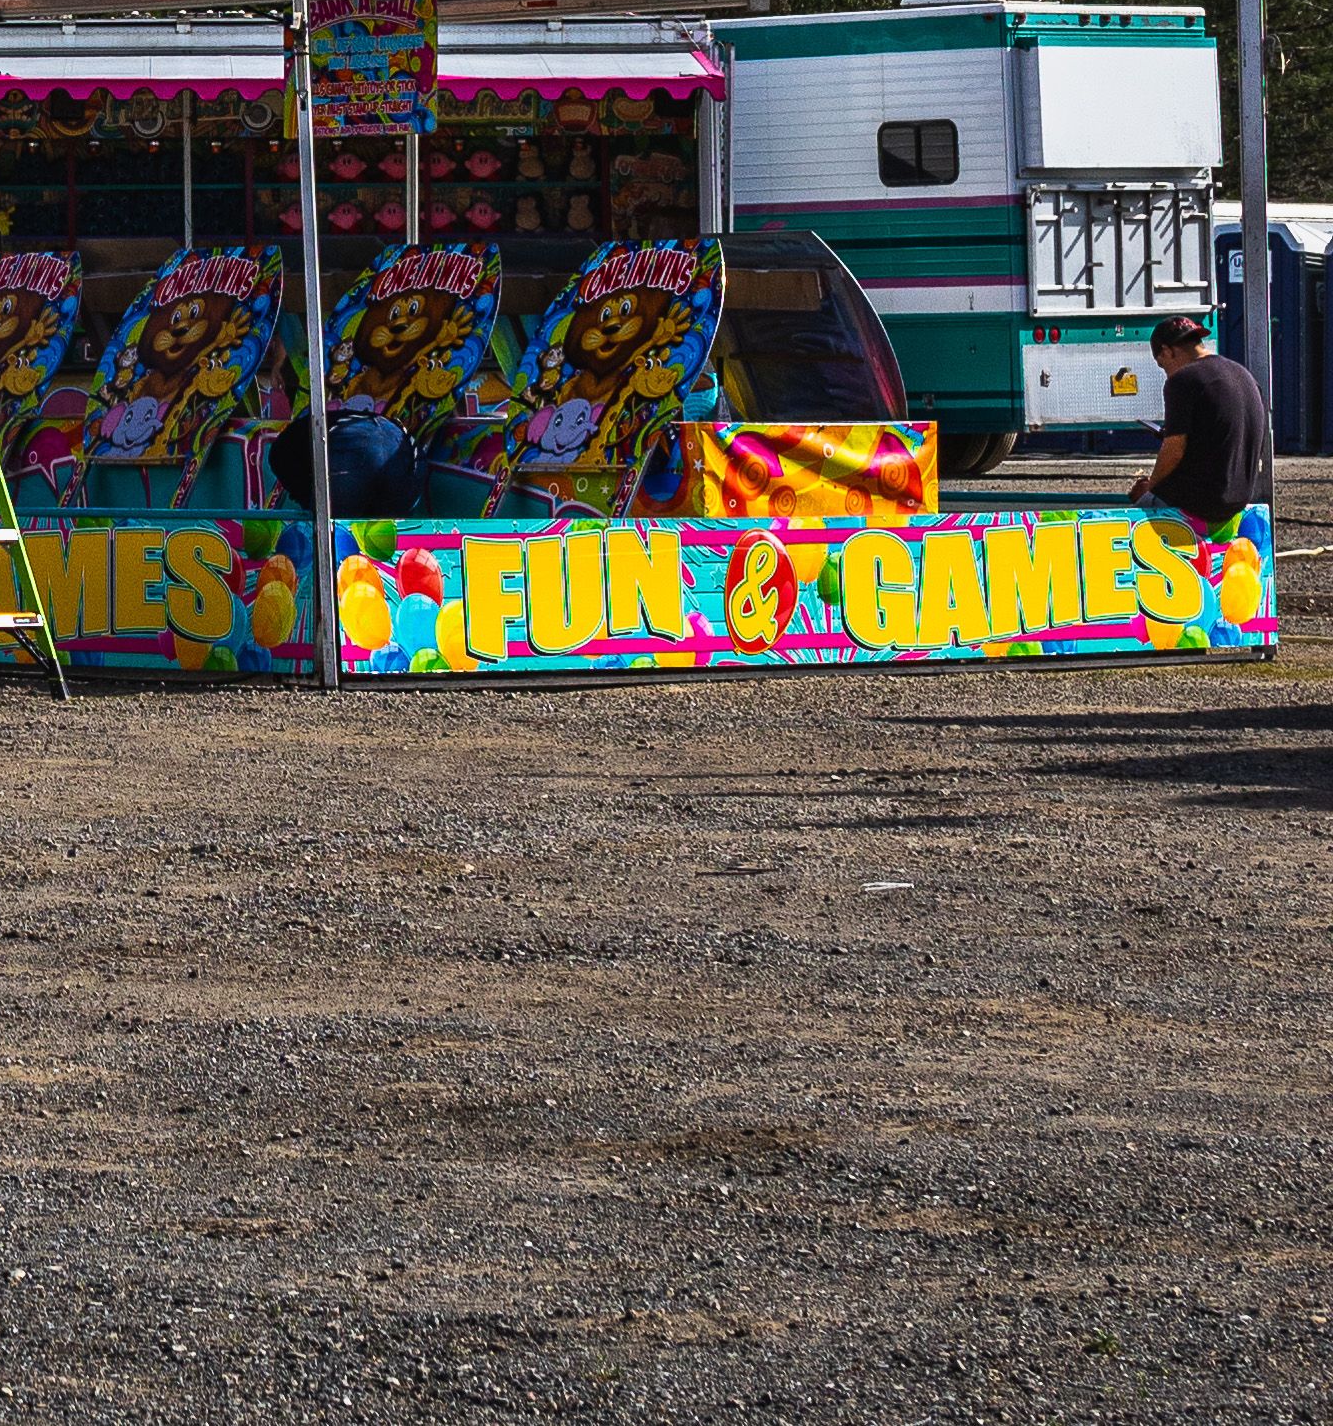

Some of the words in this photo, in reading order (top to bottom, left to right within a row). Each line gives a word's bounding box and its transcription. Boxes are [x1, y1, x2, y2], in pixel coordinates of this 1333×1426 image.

[9, 253, 38, 289] IN
[27, 255, 69, 301] WINS
[159, 258, 205, 306] ONE
[193, 255, 225, 293] IN
[214, 255, 259, 301] WINS
[377, 253, 425, 300] ONE
[413, 251, 446, 289] IN
[435, 252, 483, 299] WINS
[585, 251, 633, 303] ONE
[624, 248, 656, 288] IN
[647, 249, 697, 295] WINS
[463, 529, 685, 662] FUN
[726, 540, 780, 645] &
[842, 519, 1204, 651] GAMES
